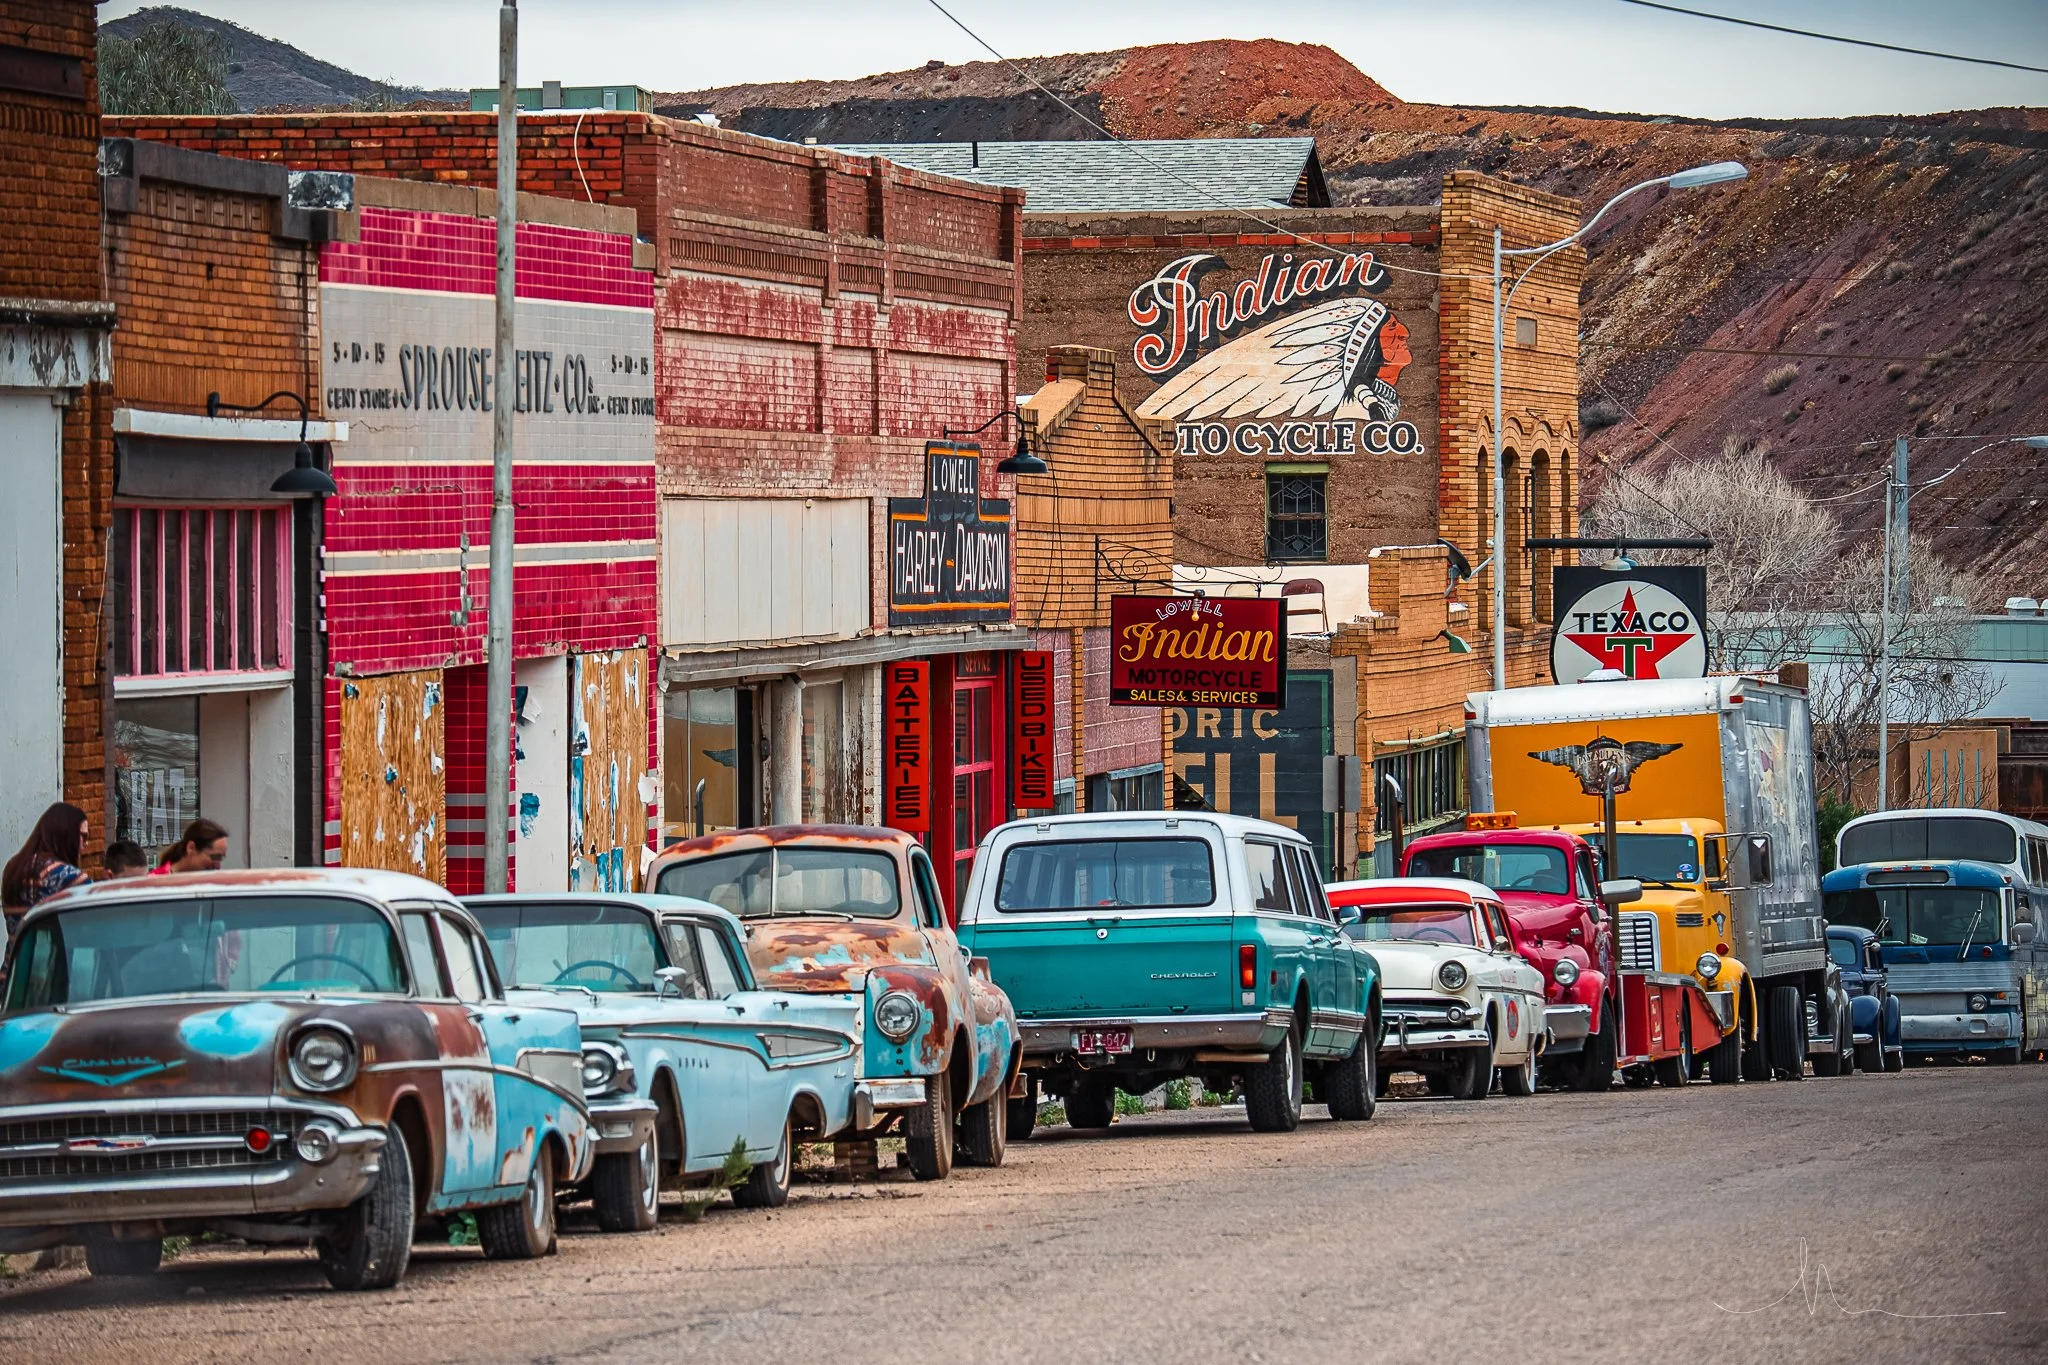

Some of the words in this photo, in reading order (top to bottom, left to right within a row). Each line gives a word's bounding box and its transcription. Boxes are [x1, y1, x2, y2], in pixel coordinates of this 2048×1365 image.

[1127, 251, 1384, 374] Indian
[400, 343, 492, 412] SPROUSE
[513, 350, 553, 413] EITZ
[327, 387, 357, 410] CENT
[359, 388, 391, 410] STORE
[608, 396, 629, 415] CENT
[1174, 423, 1229, 455] TO
[1362, 422, 1424, 455] CO.
[932, 457, 974, 494] LOWELL
[1572, 611, 1690, 633] TEXACO
[1119, 621, 1274, 662] Indian
[1020, 655, 1046, 717] USED
[1128, 668, 1262, 689] MOTORCYCLE
[1192, 690, 1258, 704] SERVICES
[894, 667, 921, 819] BATTERIES
[1020, 722, 1046, 799] BIKES
[1150, 971, 1218, 980] CHEVROLET
[1081, 1032, 1127, 1048] FY-647
